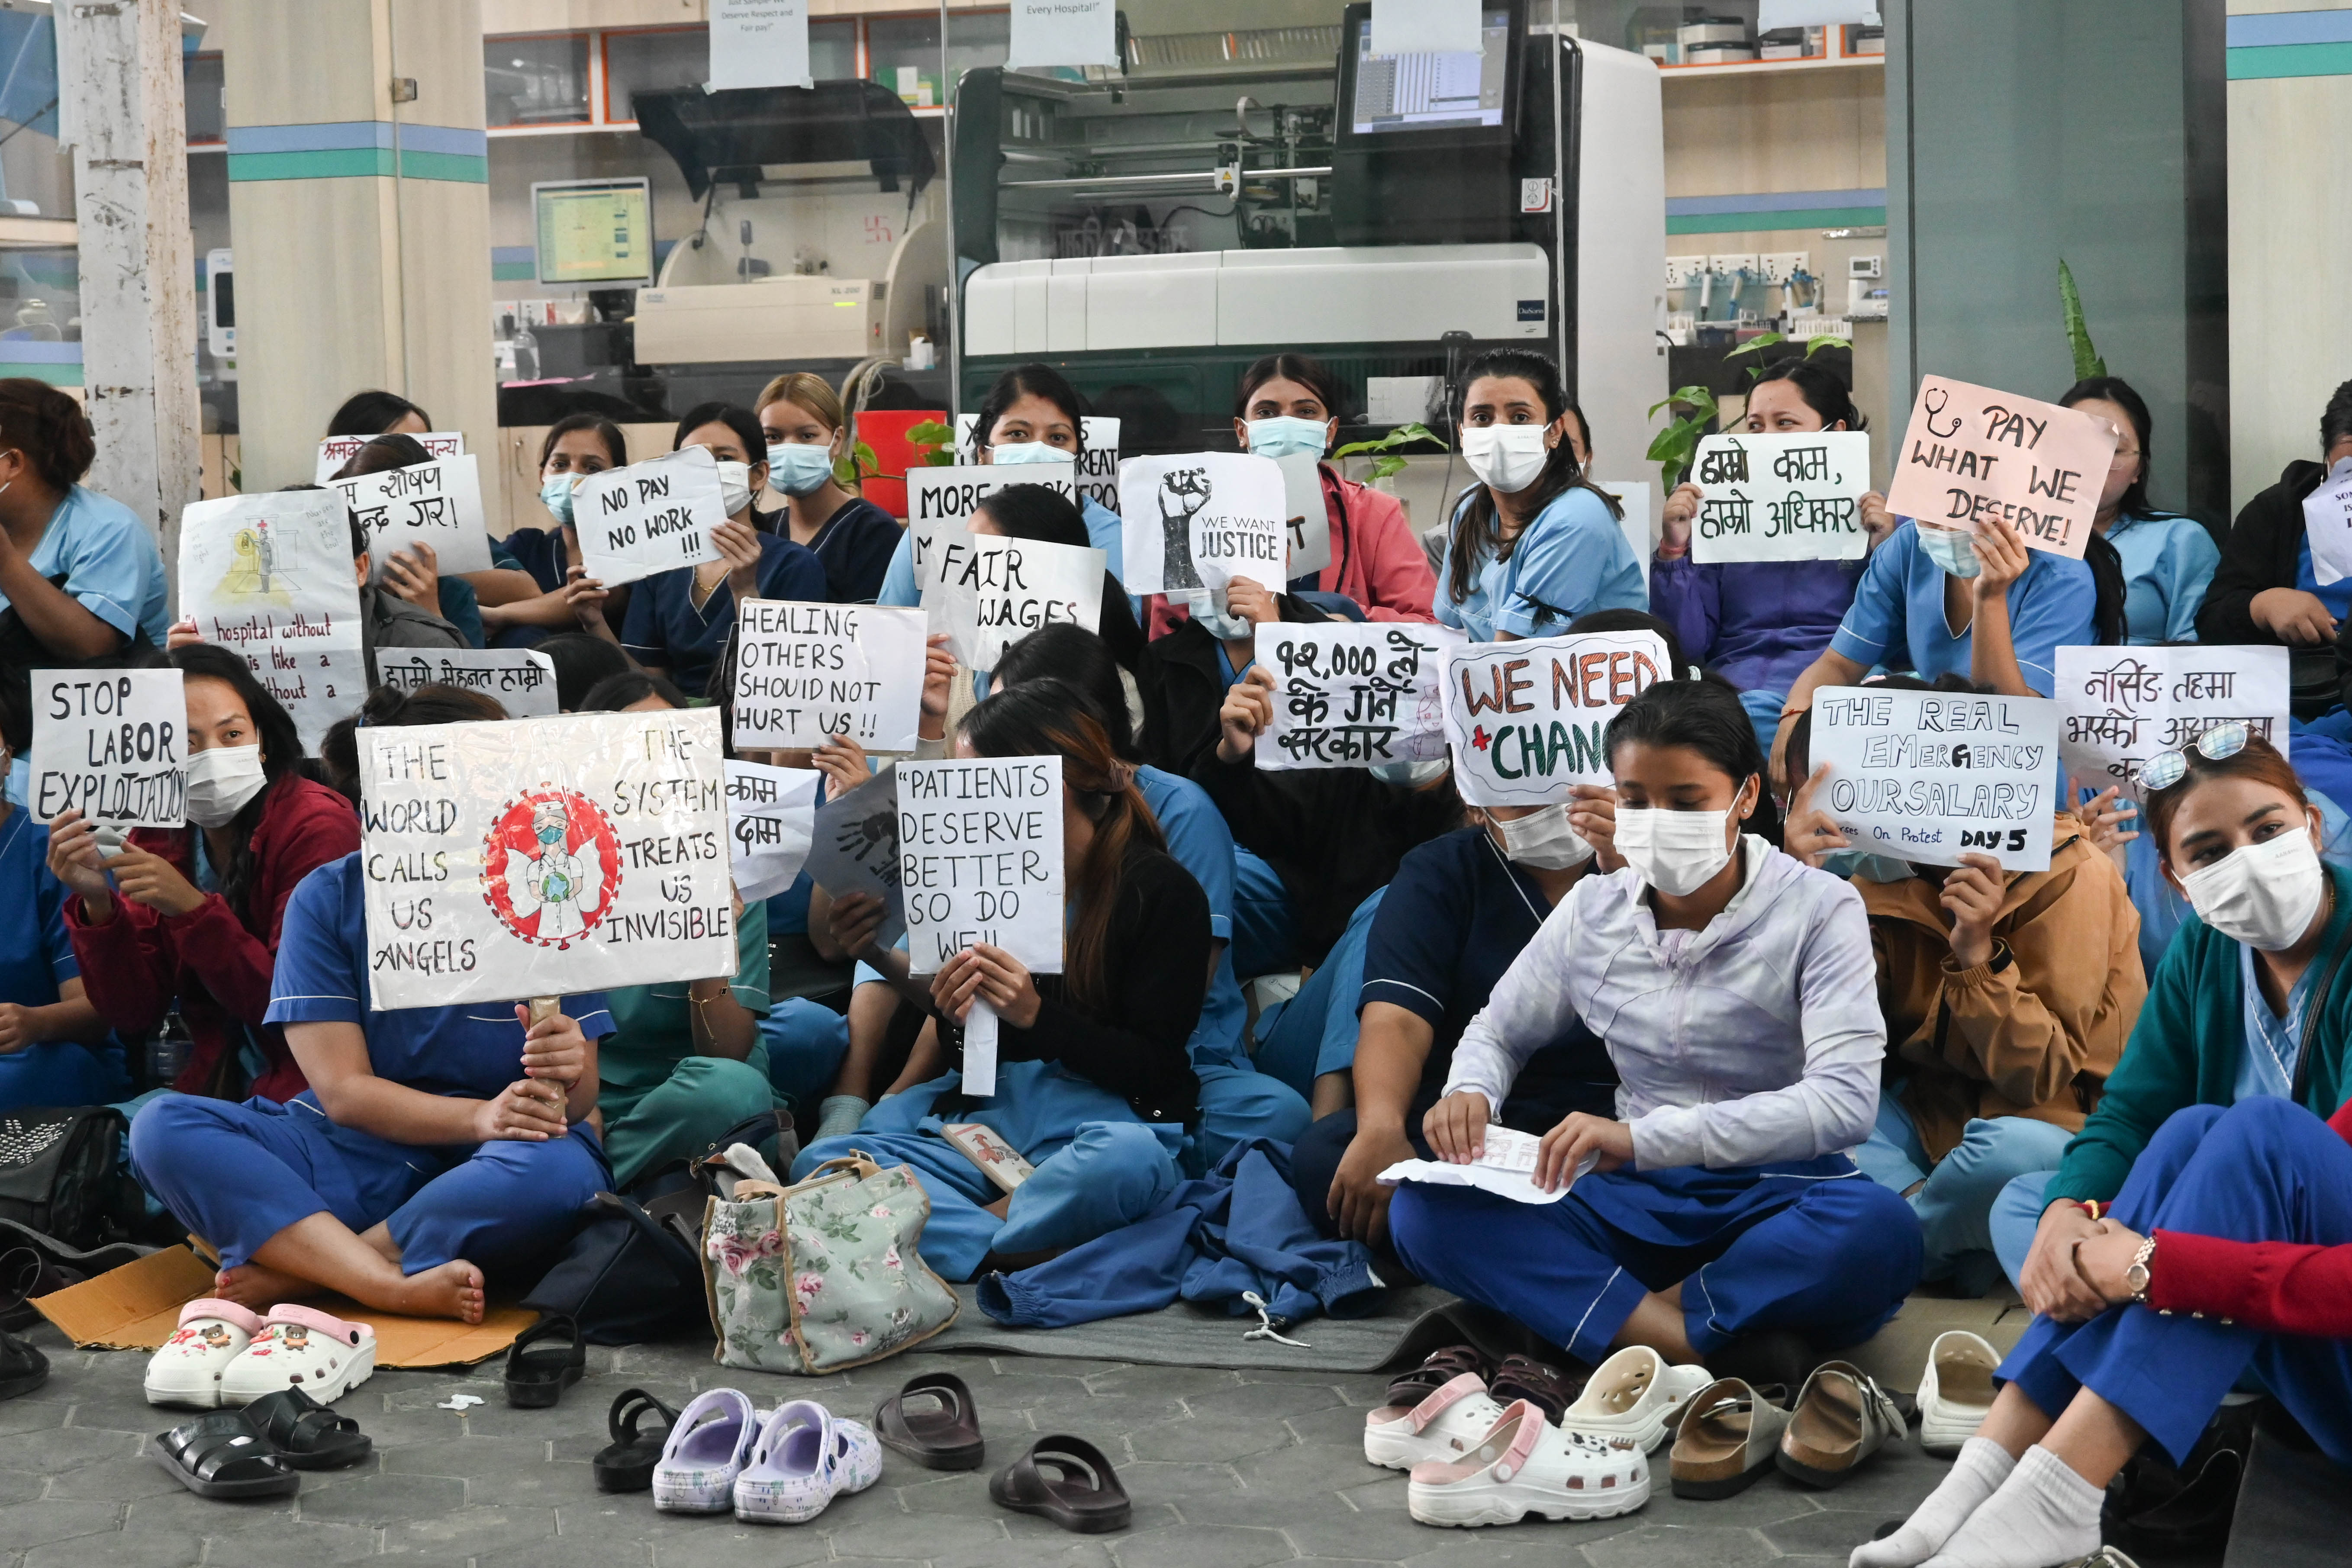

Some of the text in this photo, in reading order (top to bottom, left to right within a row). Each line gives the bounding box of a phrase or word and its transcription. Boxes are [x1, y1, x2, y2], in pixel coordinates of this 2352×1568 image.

[751, 10, 778, 19] Respect
[1027, 6, 1052, 15] Every
[1982, 405, 2048, 450] PAY
[1911, 440, 2081, 504] WHAT WE
[336, 482, 358, 504] म
[602, 475, 669, 515] NO PAY
[608, 506, 693, 551] NO WORK
[1202, 516, 1228, 528] WE
[1234, 517, 1276, 533] WANT
[1765, 490, 1857, 538] अधिकार
[1199, 531, 1278, 561] JUSTICE
[941, 544, 1028, 592] FAIR
[215, 614, 273, 647] hospital
[282, 612, 332, 640] without
[741, 606, 858, 643] HEALING
[977, 598, 1077, 630] WAGES
[271, 645, 296, 670] like
[320, 654, 330, 667] a
[741, 642, 844, 670] OTHERS
[51, 676, 132, 720] STOP
[261, 674, 336, 700] thout a
[830, 680, 881, 703] NOT
[1462, 651, 1658, 717] WE NEED
[2173, 672, 2236, 702] तहमा
[736, 707, 802, 735] HURT
[1823, 697, 2020, 735] THE REAL
[2066, 708, 2152, 749] भएको
[89, 721, 176, 767] LABOR
[637, 729, 693, 761] THE
[1278, 725, 1400, 763] सरकार
[1862, 734, 2043, 771] EMERGENCY
[380, 744, 447, 781] THE
[38, 767, 190, 822] EXPLOITATION
[614, 779, 718, 816] SYSTEM
[725, 775, 778, 803] काम
[364, 798, 457, 835] WORLD
[901, 811, 1044, 845] DESERVE
[625, 832, 718, 869] TREATS
[735, 814, 783, 856] दाम
[1873, 826, 1891, 840] On
[1901, 827, 1943, 844] Protest
[369, 851, 448, 883] CALLS
[903, 850, 1048, 888] BETTER
[661, 875, 693, 905] US
[908, 890, 1020, 925] SO DO
[392, 898, 432, 931] US
[606, 907, 730, 943] INVISIBLE
[373, 939, 476, 976] ANGELS
